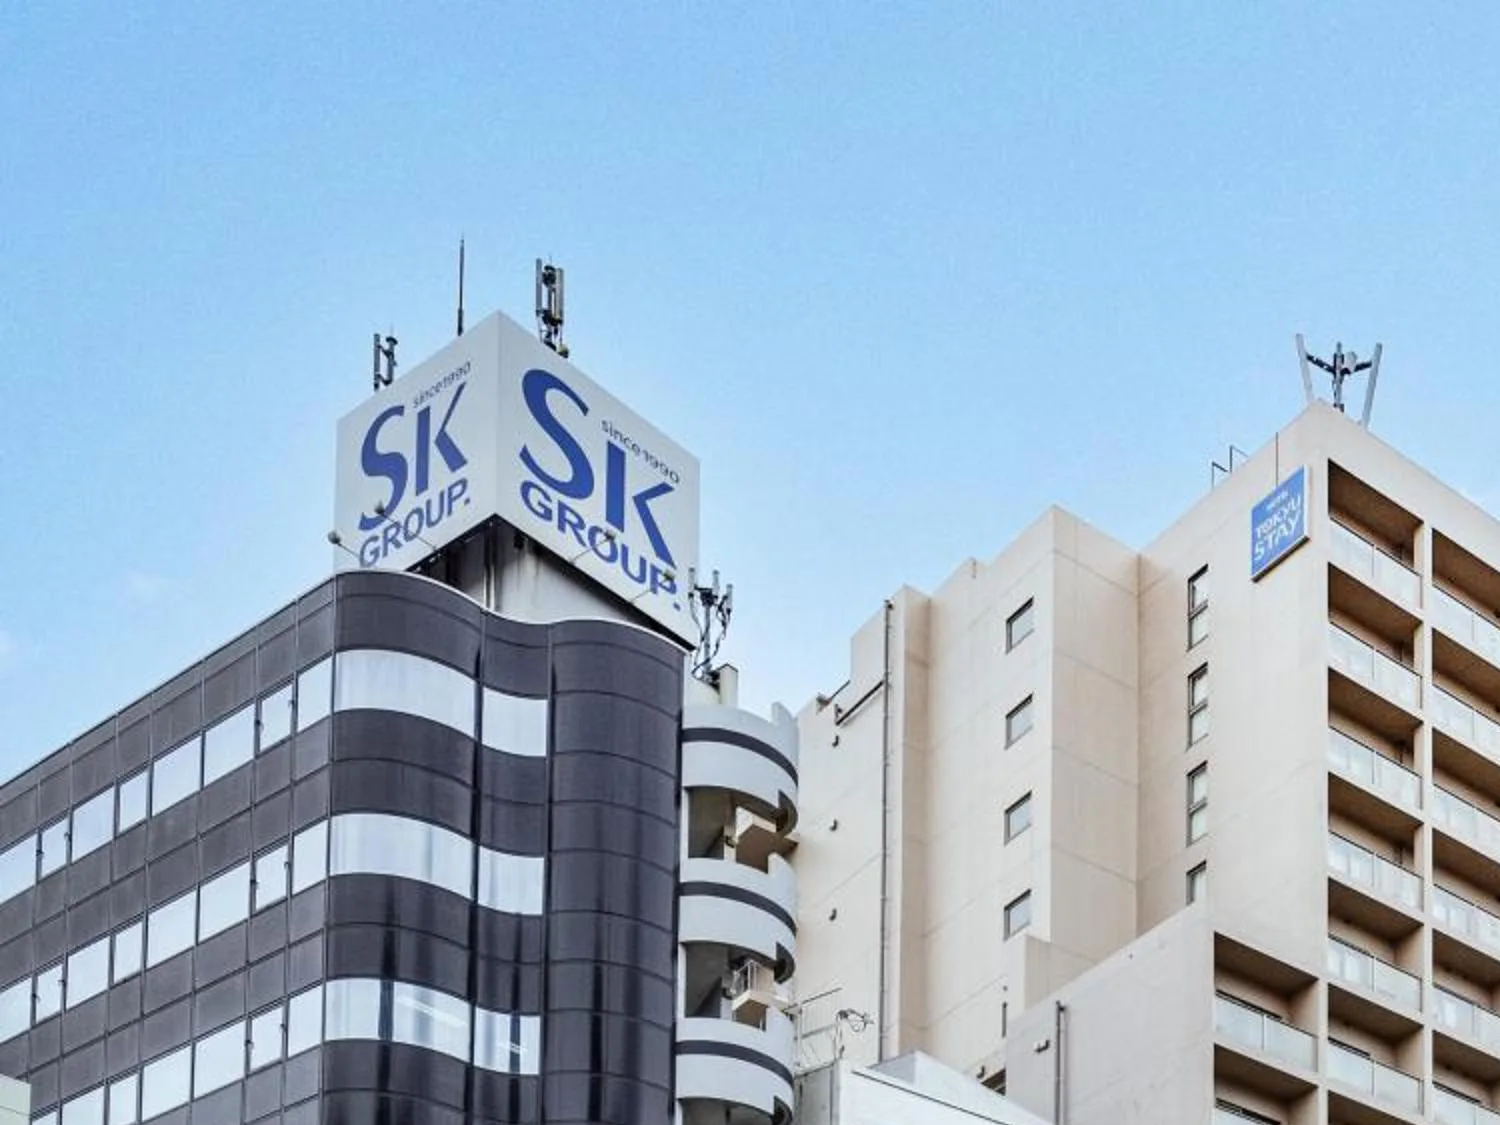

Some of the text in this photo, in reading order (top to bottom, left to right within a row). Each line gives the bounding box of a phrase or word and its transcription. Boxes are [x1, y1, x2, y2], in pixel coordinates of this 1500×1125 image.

[358, 382, 468, 531] SK
[519, 368, 676, 569] SK
[1255, 494, 1301, 538] TOKYU
[1255, 511, 1300, 561] STAY
